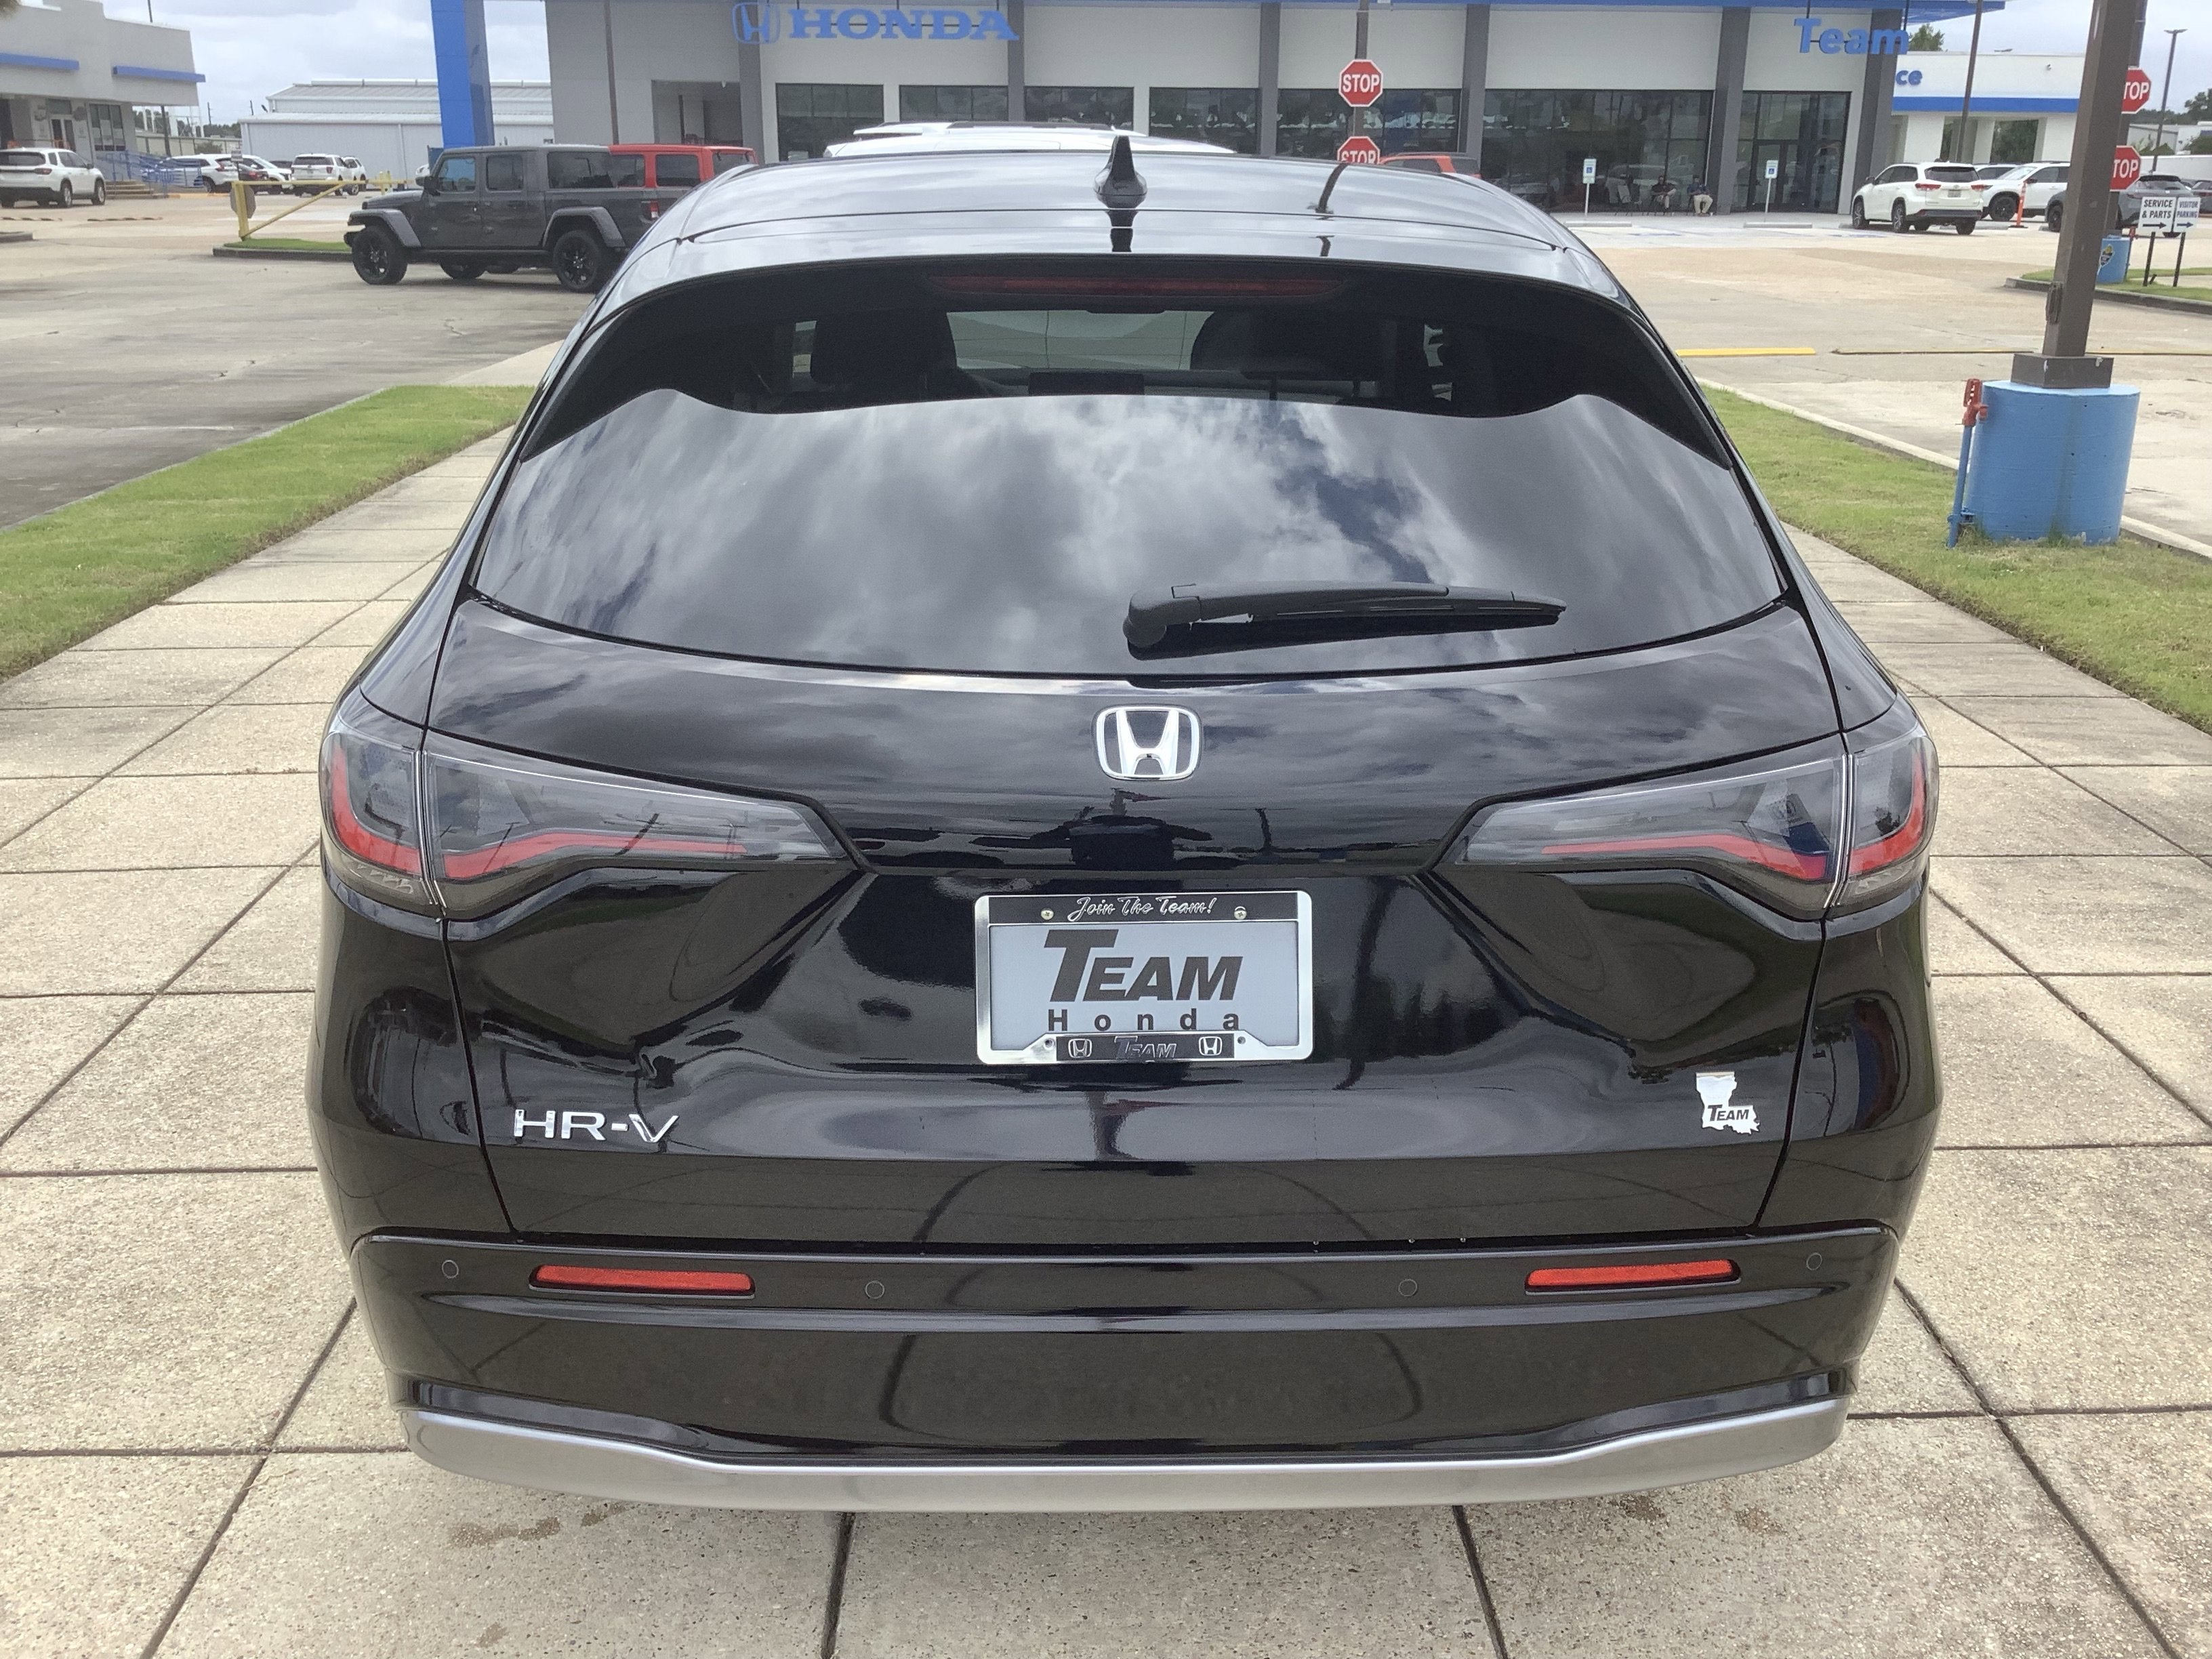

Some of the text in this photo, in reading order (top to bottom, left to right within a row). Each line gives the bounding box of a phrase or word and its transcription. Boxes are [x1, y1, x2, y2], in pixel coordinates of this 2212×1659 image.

[788, 8, 1019, 41] HONDA
[1794, 17, 1909, 55] Team
[1343, 74, 1380, 92] STOP
[2123, 81, 2150, 100] TOP
[2113, 159, 2139, 178] TOP
[2142, 210, 2148, 218] &
[2144, 199, 2173, 208] SERVICE
[1067, 895, 1217, 922] Join The Team!
[1044, 929, 1243, 1002] TEAM
[1048, 1008, 1239, 1031] Honda
[1114, 1036, 1176, 1059] TEAM
[1708, 1105, 1749, 1122] TEAM
[514, 1109, 679, 1143] HR-V
